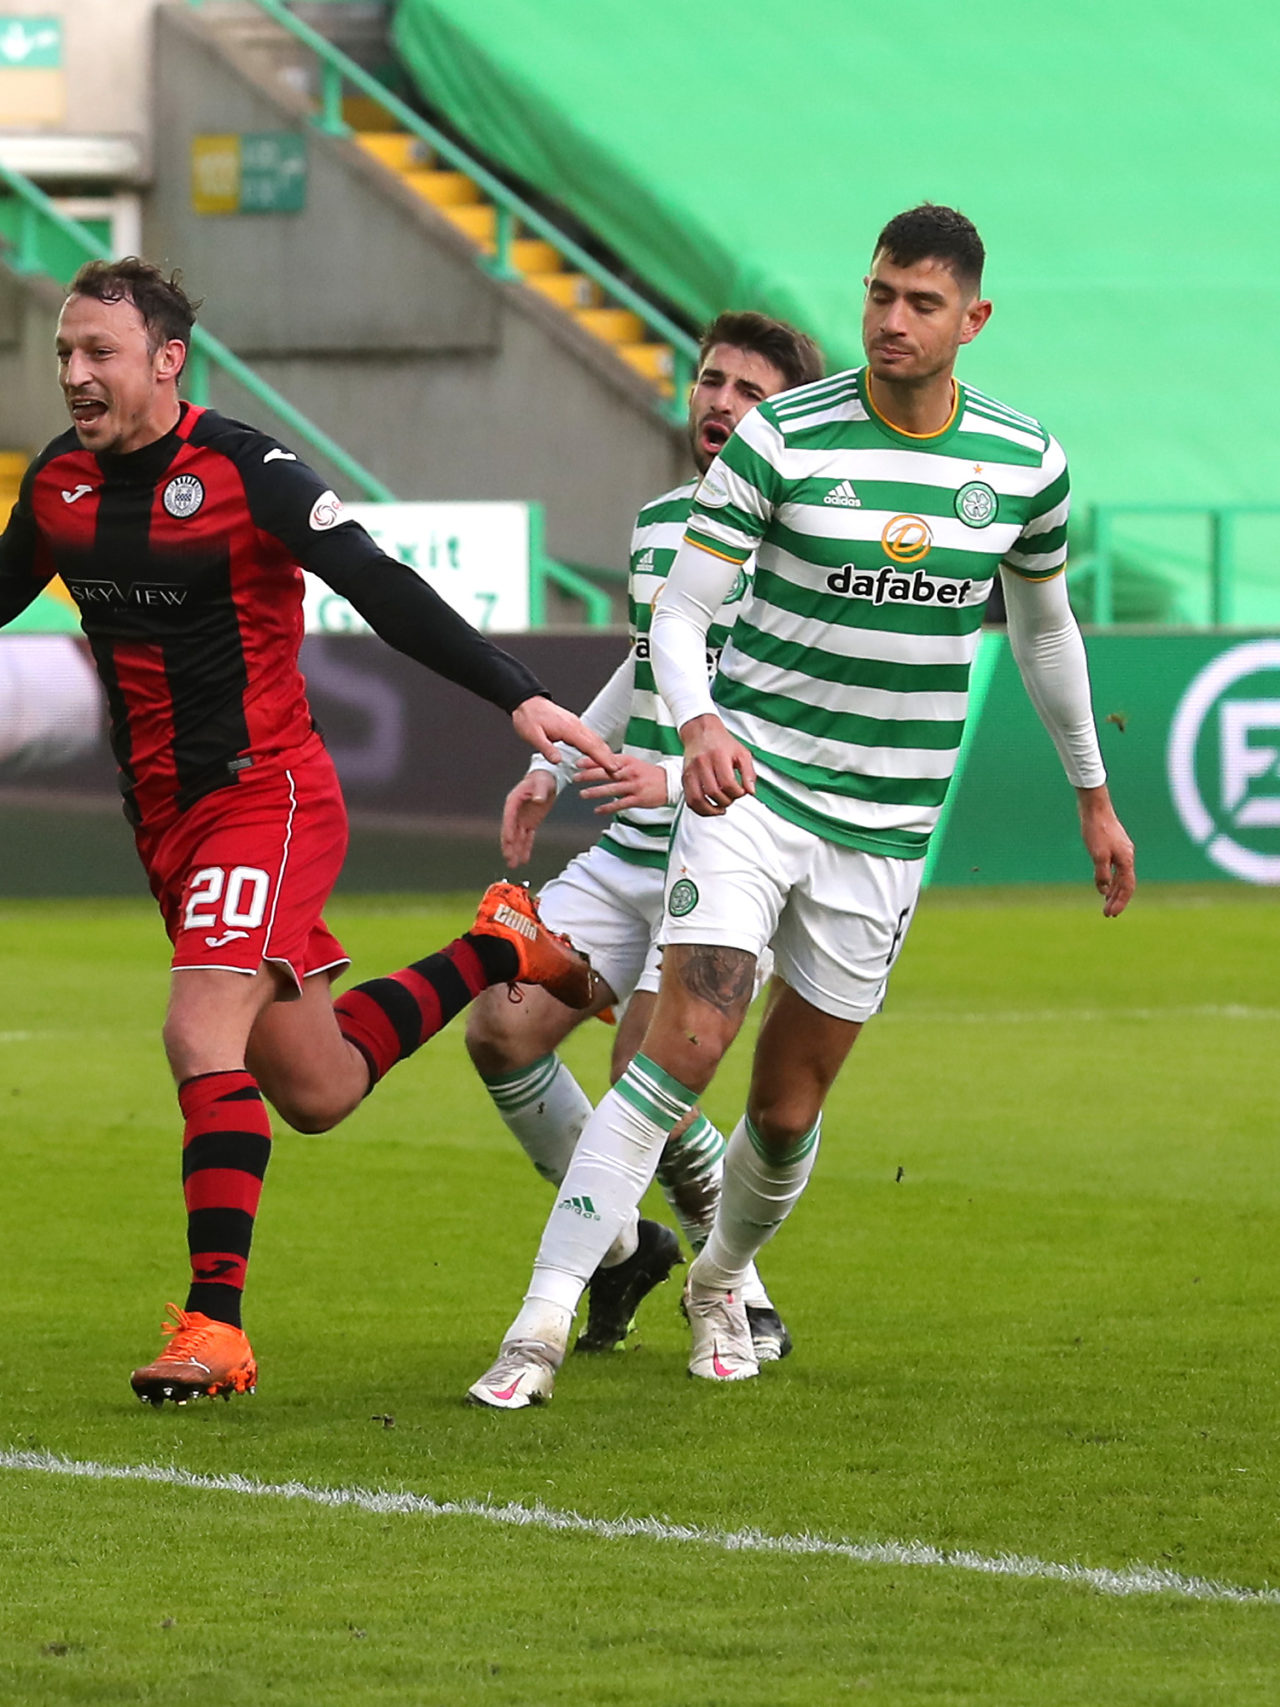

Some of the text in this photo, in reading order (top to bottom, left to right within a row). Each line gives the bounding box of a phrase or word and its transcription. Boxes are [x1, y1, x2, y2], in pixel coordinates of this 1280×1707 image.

[823, 495, 862, 508] adidas
[370, 530, 462, 570] xit
[826, 565, 972, 605] dafabet
[183, 866, 270, 930] 20
